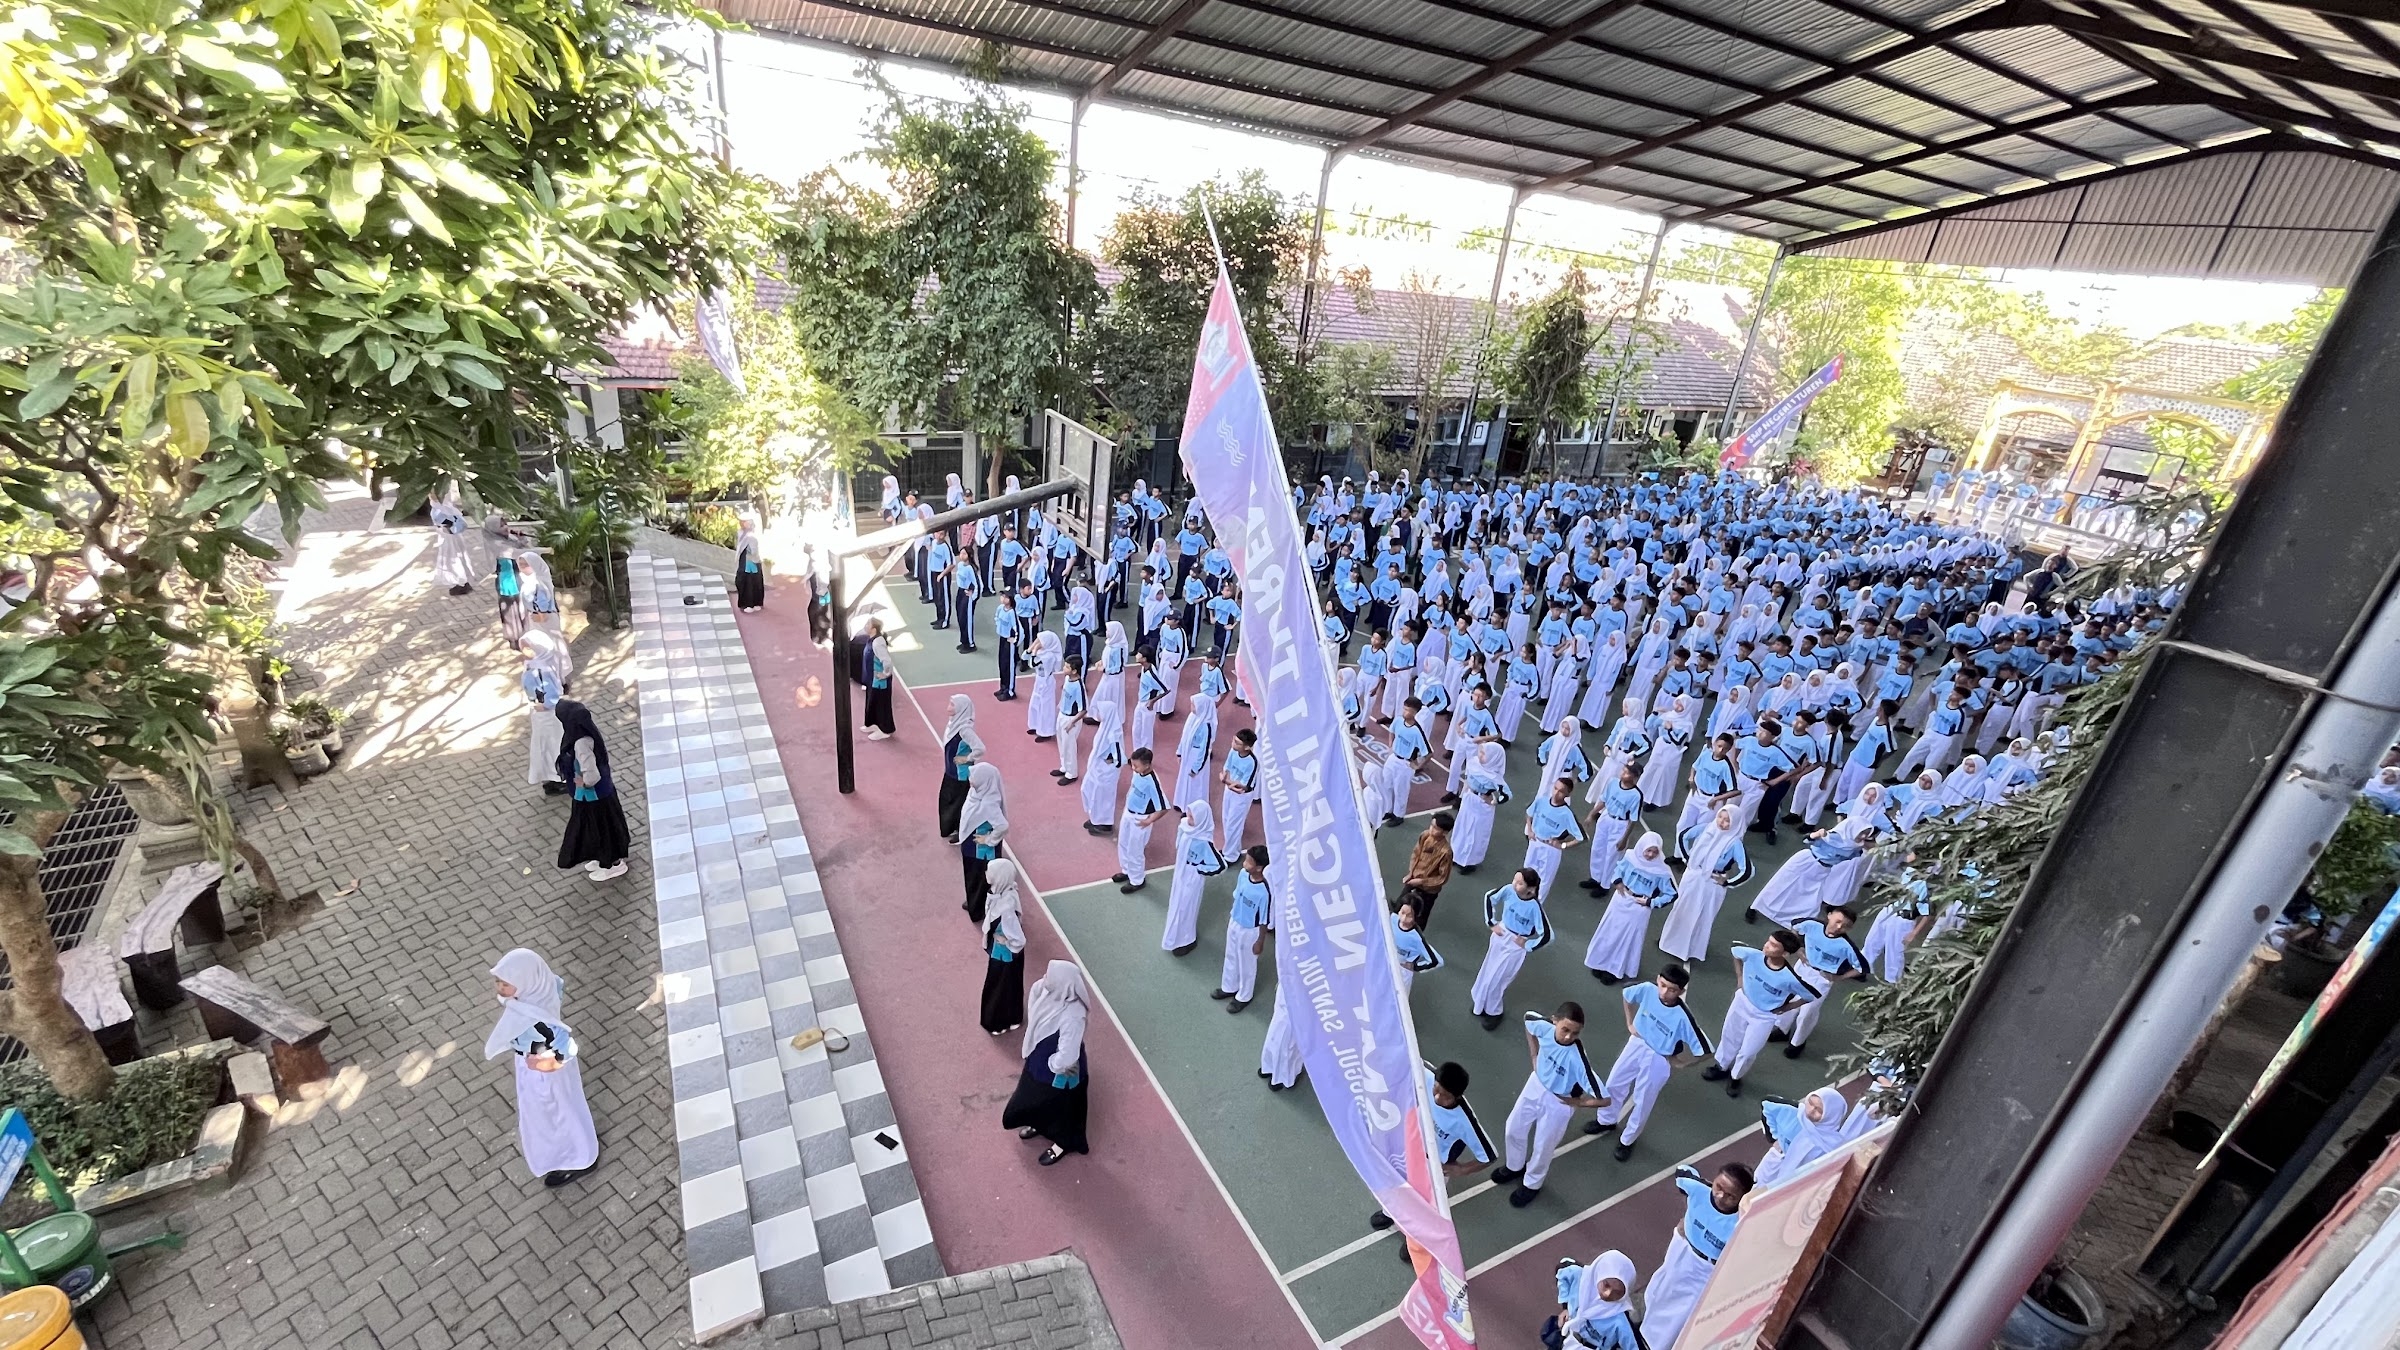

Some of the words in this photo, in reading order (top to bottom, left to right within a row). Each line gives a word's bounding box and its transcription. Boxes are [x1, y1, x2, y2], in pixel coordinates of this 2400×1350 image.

[1746, 427, 1763, 444] SMP
[1762, 402, 1793, 430] NEGERI
[1794, 377, 1824, 401] TUREN
